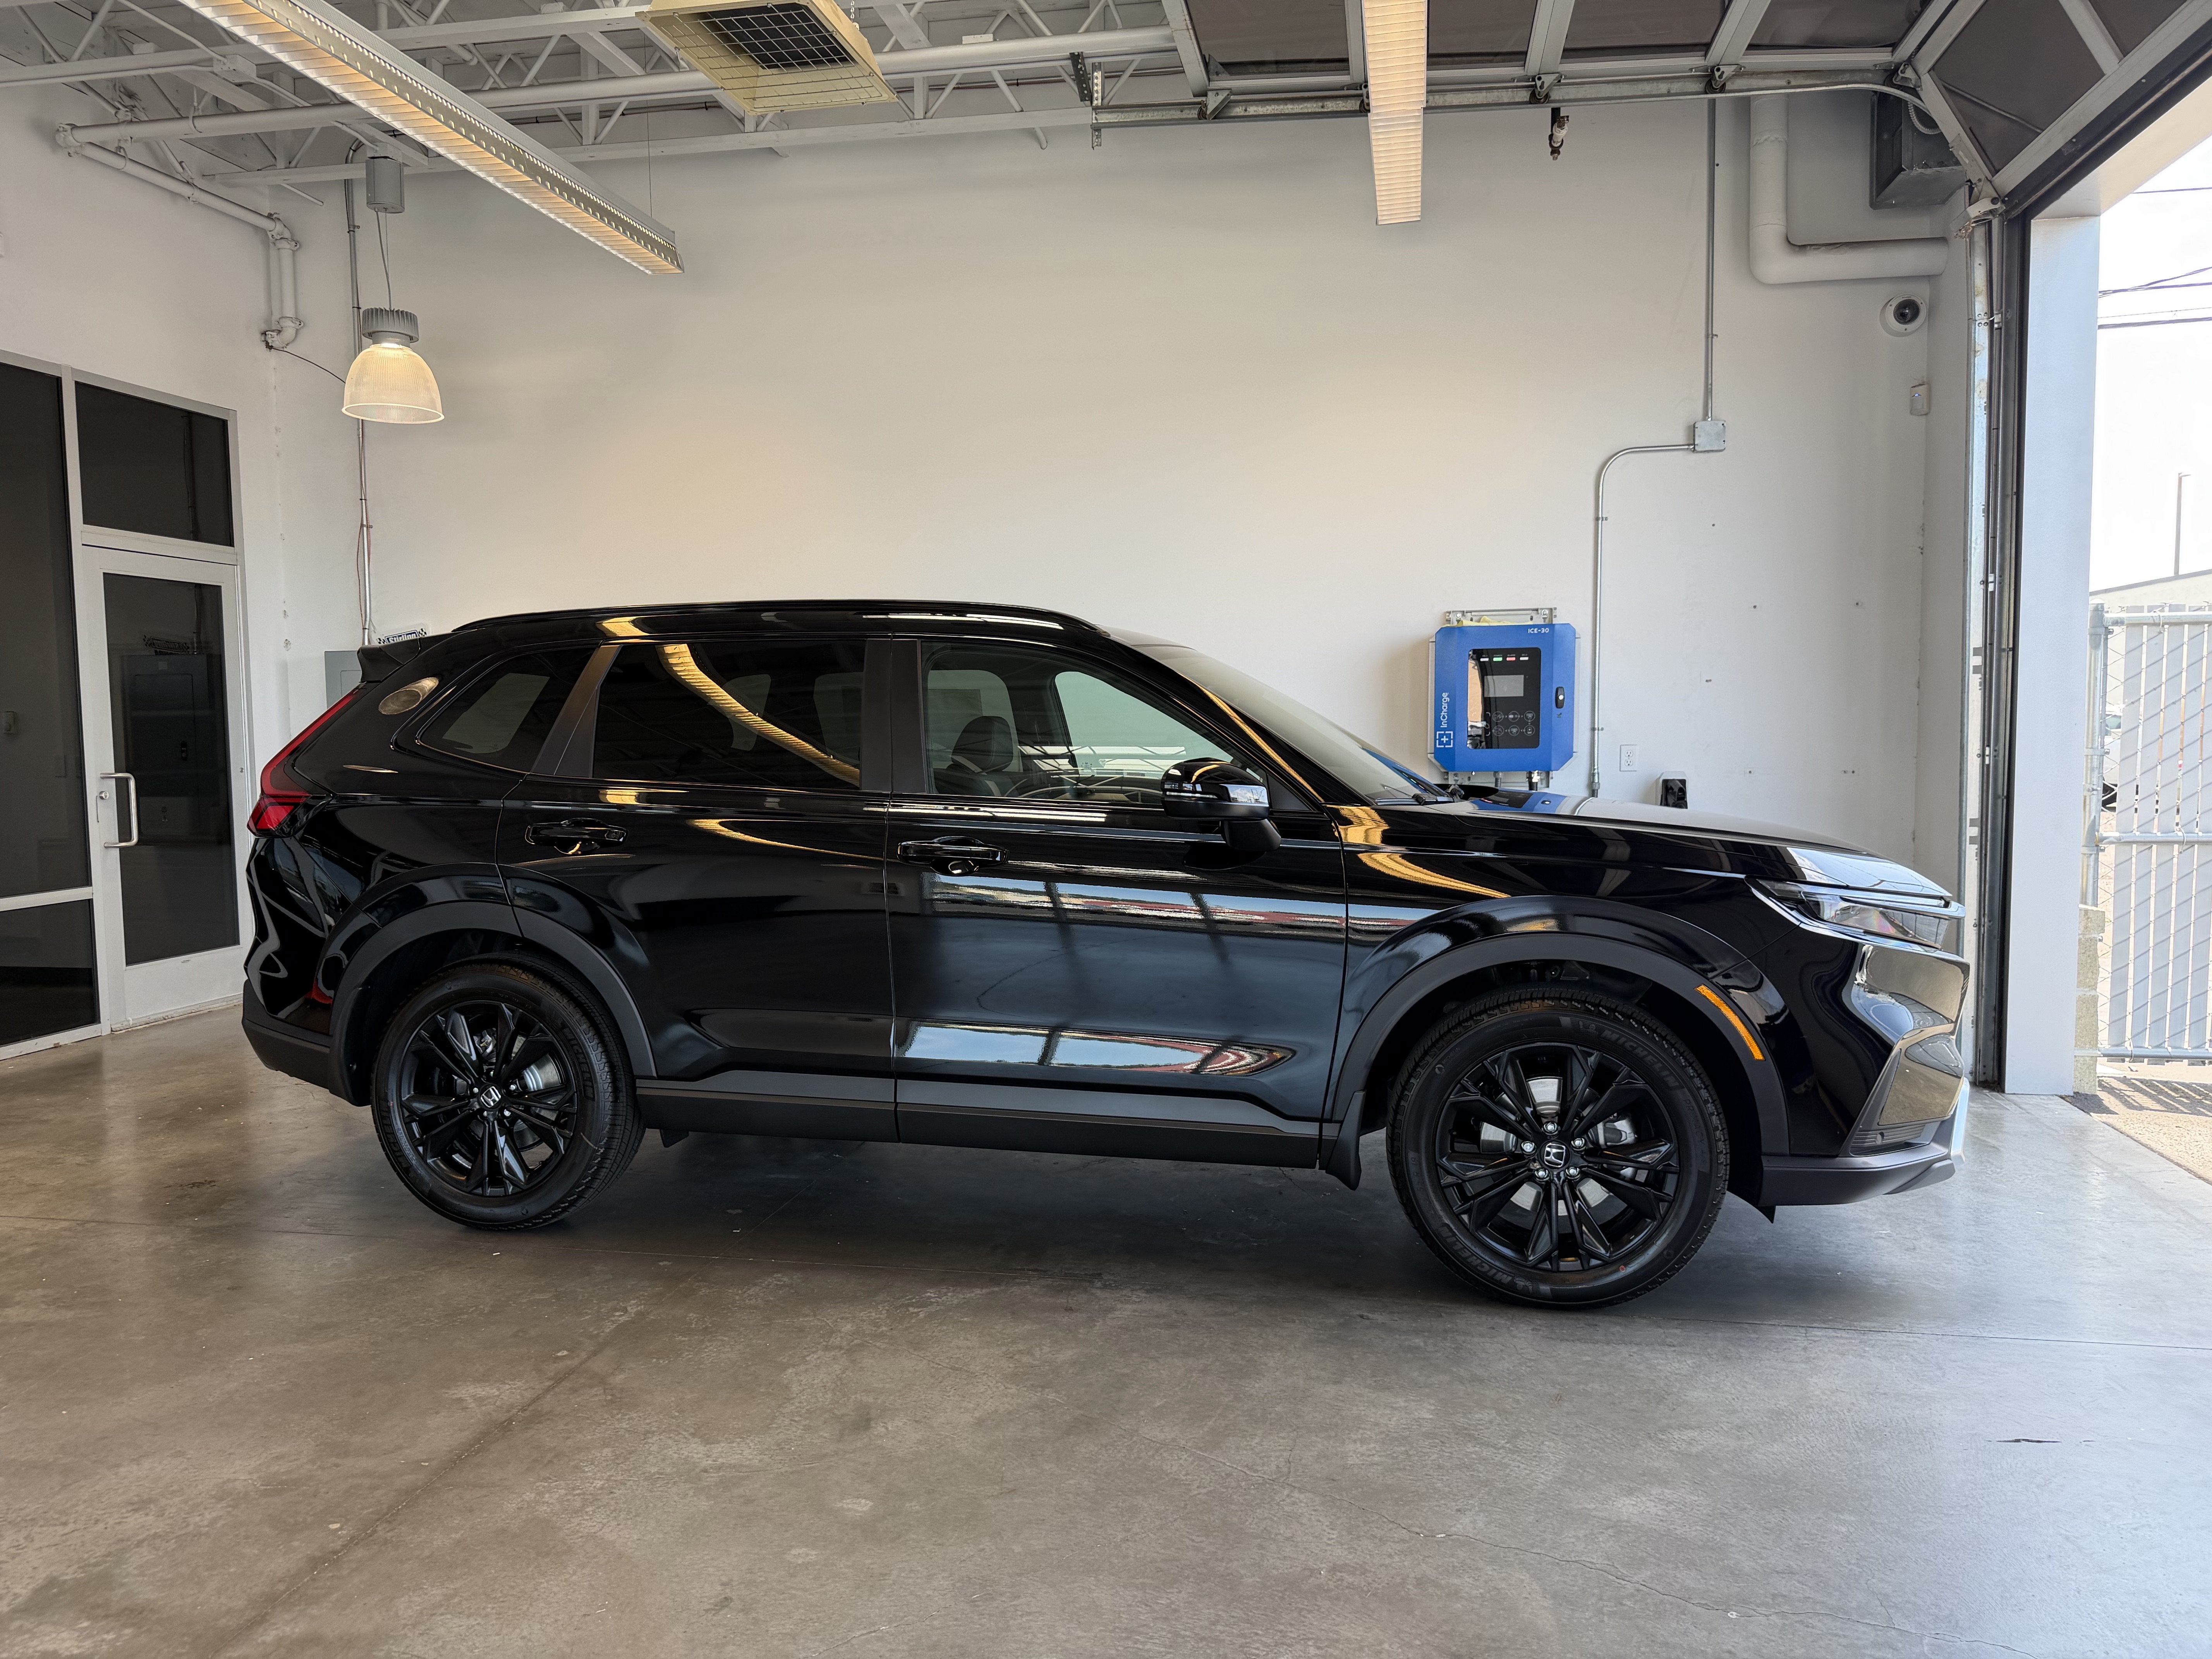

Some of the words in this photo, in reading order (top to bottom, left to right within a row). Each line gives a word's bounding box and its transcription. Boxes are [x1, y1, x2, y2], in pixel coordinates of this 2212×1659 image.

[1440, 692, 1449, 728] InCharge
[562, 1027, 593, 1097] MICHELIN
[1600, 1029, 1680, 1088] MICHELIN
[1683, 1099, 1705, 1144] PRMACY
[1437, 1224, 1512, 1284] MICHELIN
